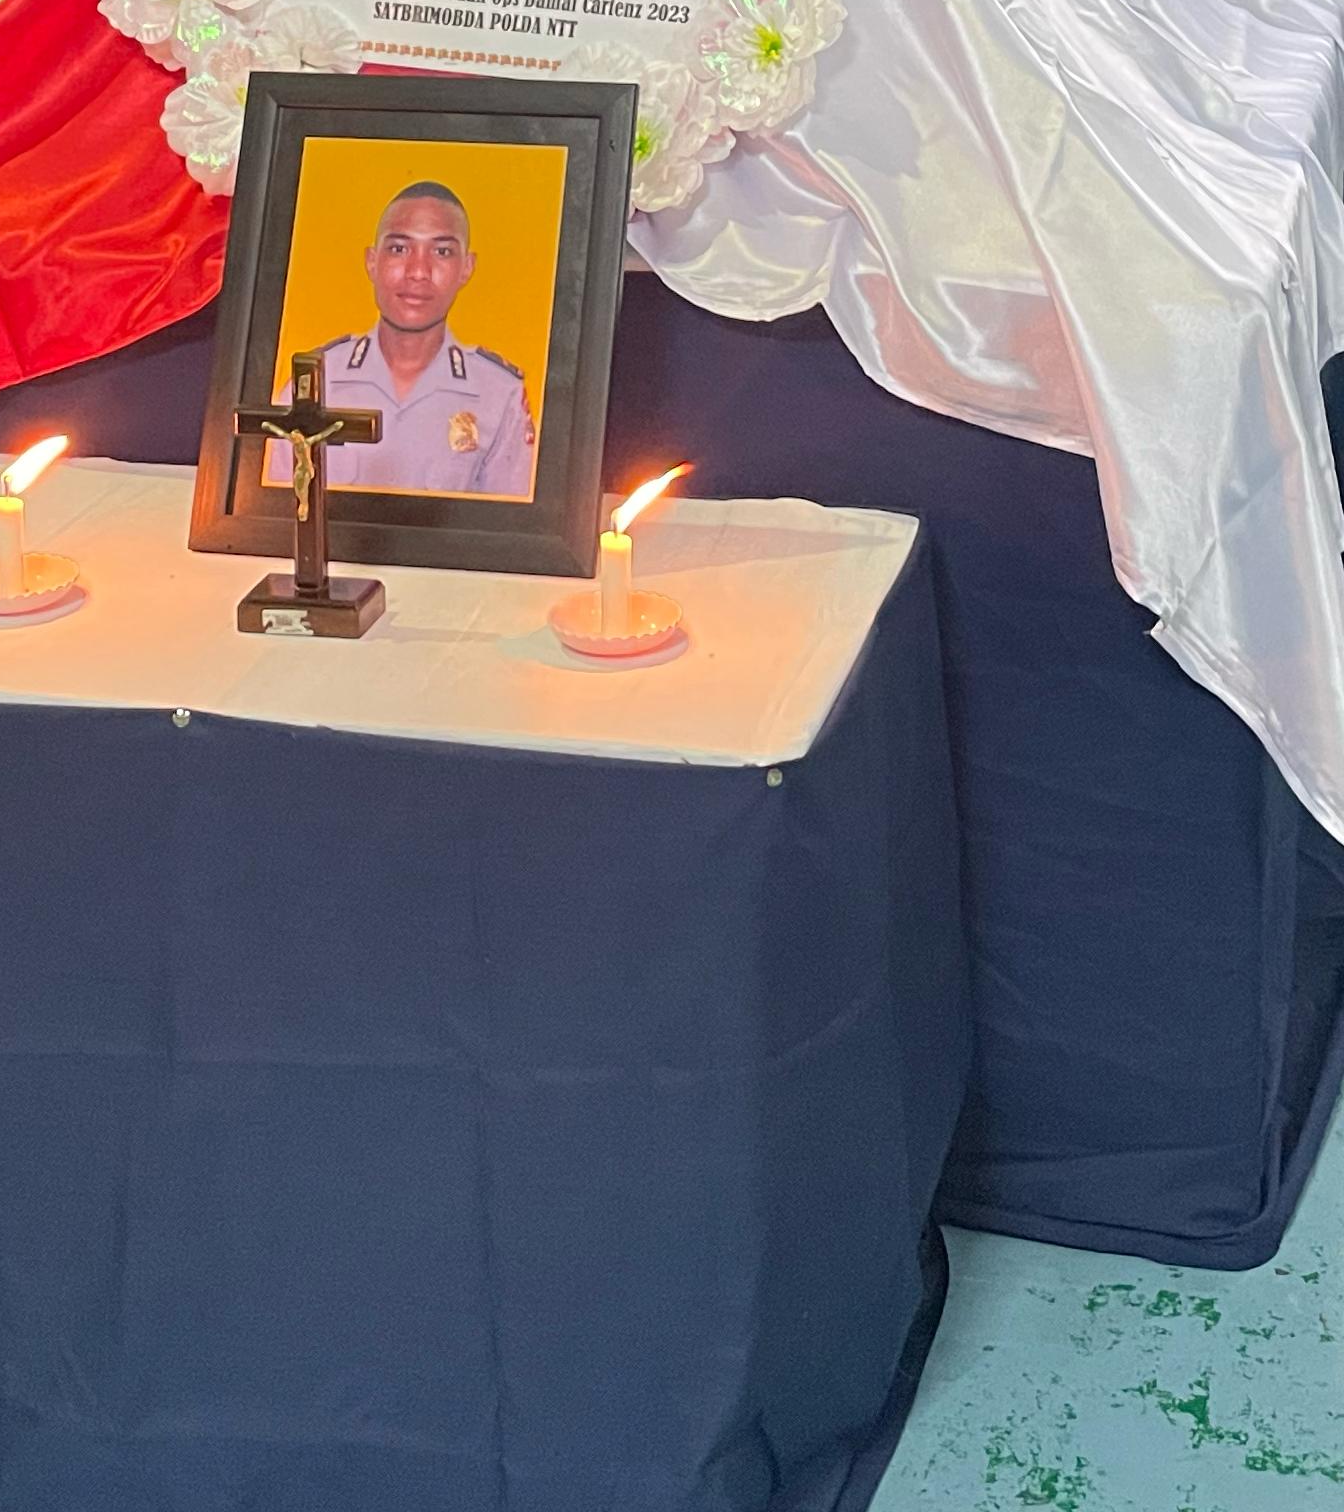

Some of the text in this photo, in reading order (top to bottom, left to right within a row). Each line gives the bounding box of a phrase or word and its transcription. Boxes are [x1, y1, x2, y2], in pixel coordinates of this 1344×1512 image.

[372, 1, 578, 38] SATBRIMOBDA POLDA NTT
[647, 3, 690, 24] 2023
